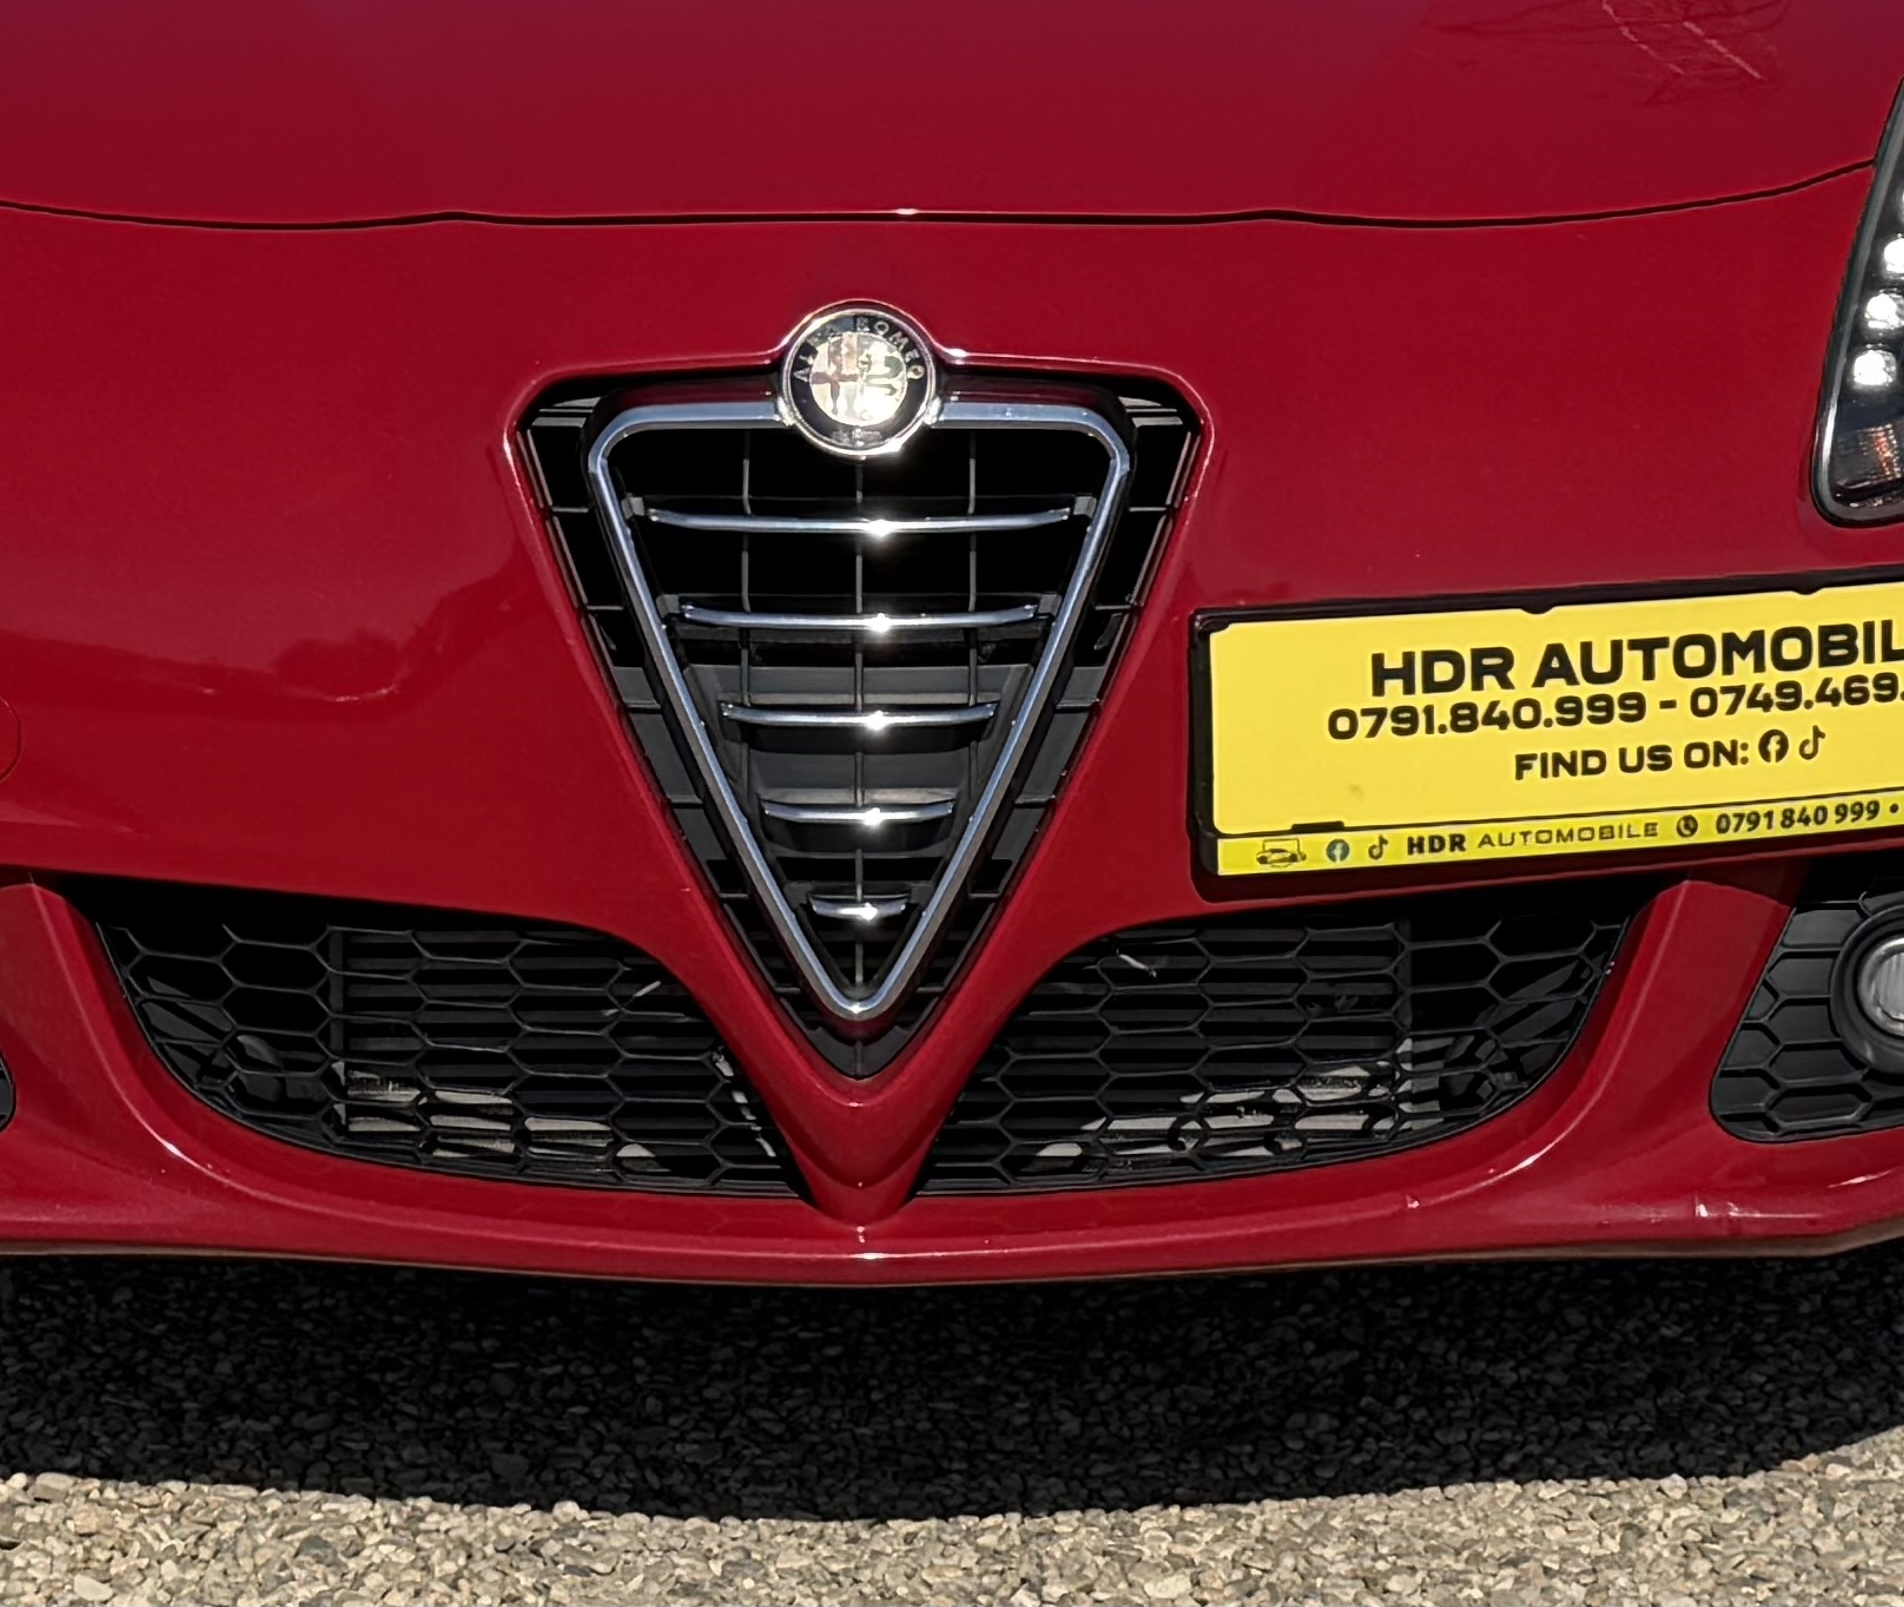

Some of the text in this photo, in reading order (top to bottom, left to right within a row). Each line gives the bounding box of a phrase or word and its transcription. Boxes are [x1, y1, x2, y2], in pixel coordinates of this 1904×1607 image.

[855, 316, 926, 381] ROMEO
[1371, 646, 1516, 697] HDR
[1327, 691, 1647, 740] 0791.840.999
[1515, 738, 1750, 781] FIND US ON:
[1407, 833, 1467, 857] HDR
[1477, 822, 1659, 850] AUTOMOBILE
[1715, 809, 1775, 835] 0791
[1780, 804, 1829, 830] 840
[1833, 799, 1881, 823] 999
